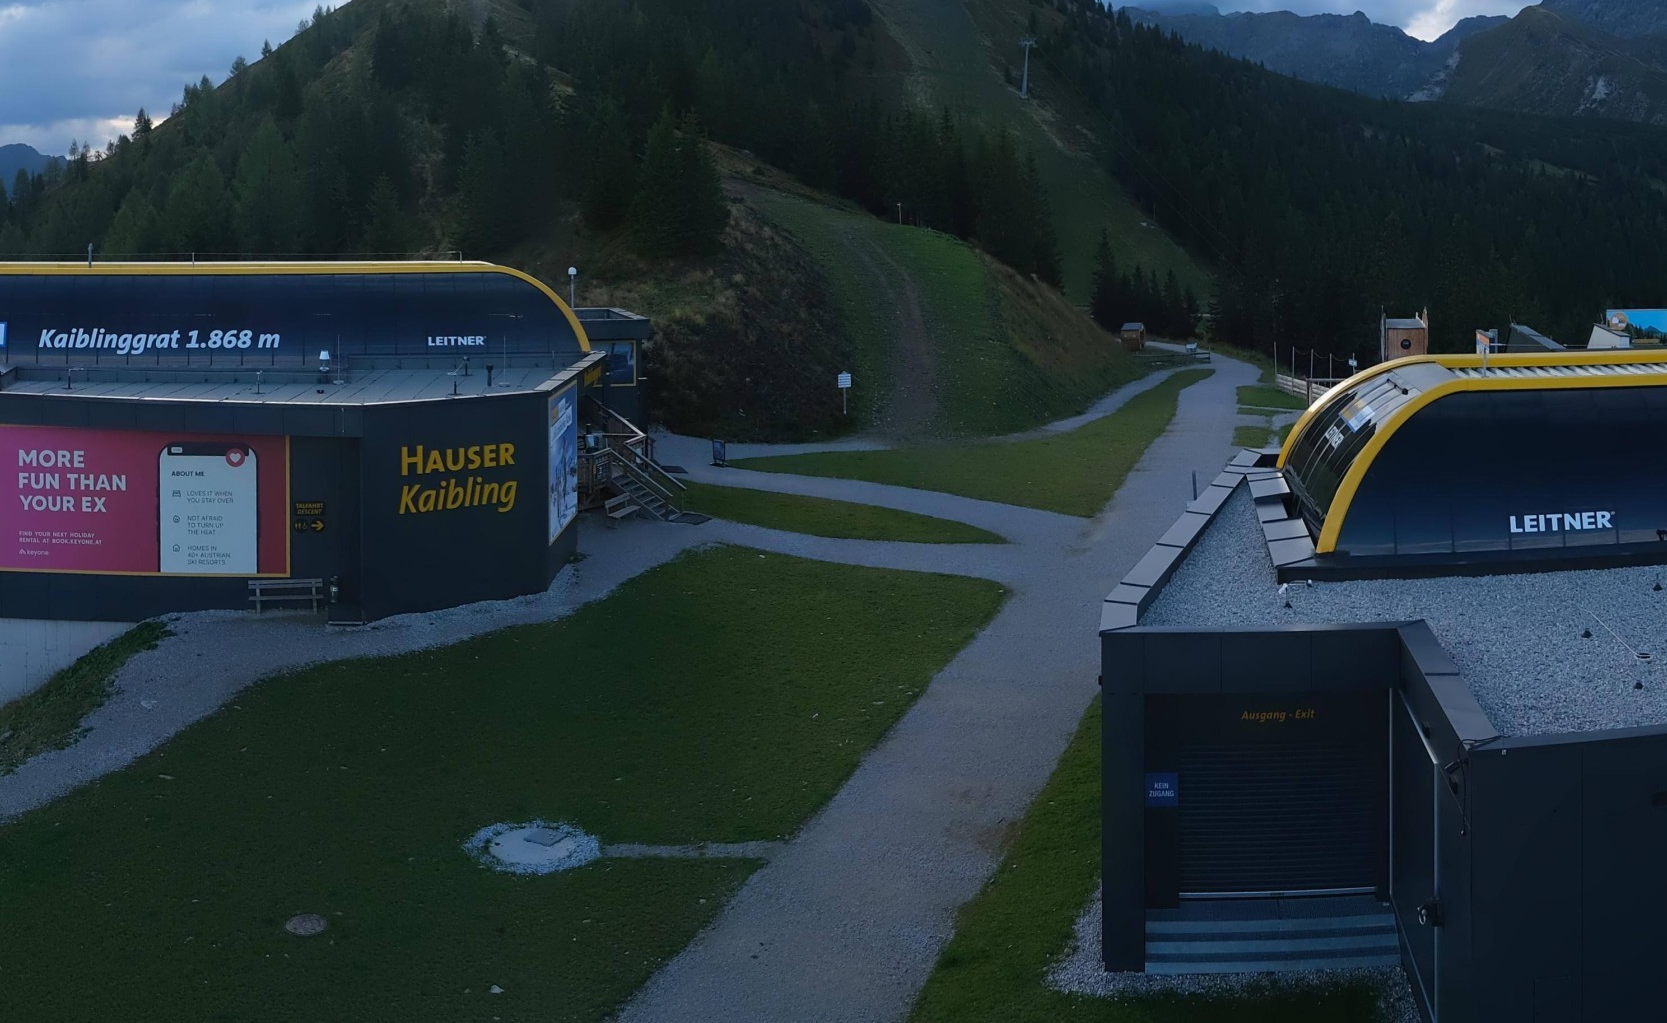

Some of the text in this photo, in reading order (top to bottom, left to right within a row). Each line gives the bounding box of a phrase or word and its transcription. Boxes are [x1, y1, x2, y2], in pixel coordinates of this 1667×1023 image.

[38, 328, 281, 355] Kaiblinggrat 1.868 m
[427, 336, 485, 346] LEITNER
[18, 449, 85, 468] MORE
[401, 443, 516, 476] HAUSER
[18, 472, 127, 491] FUN THAN
[19, 495, 107, 513] YOUR EX
[398, 476, 518, 515] Kaibling
[1509, 510, 1613, 533] LEITNER
[26, 548, 49, 557] keyone
[1241, 710, 1286, 723] Ausgang
[1295, 709, 1315, 719] Exit
